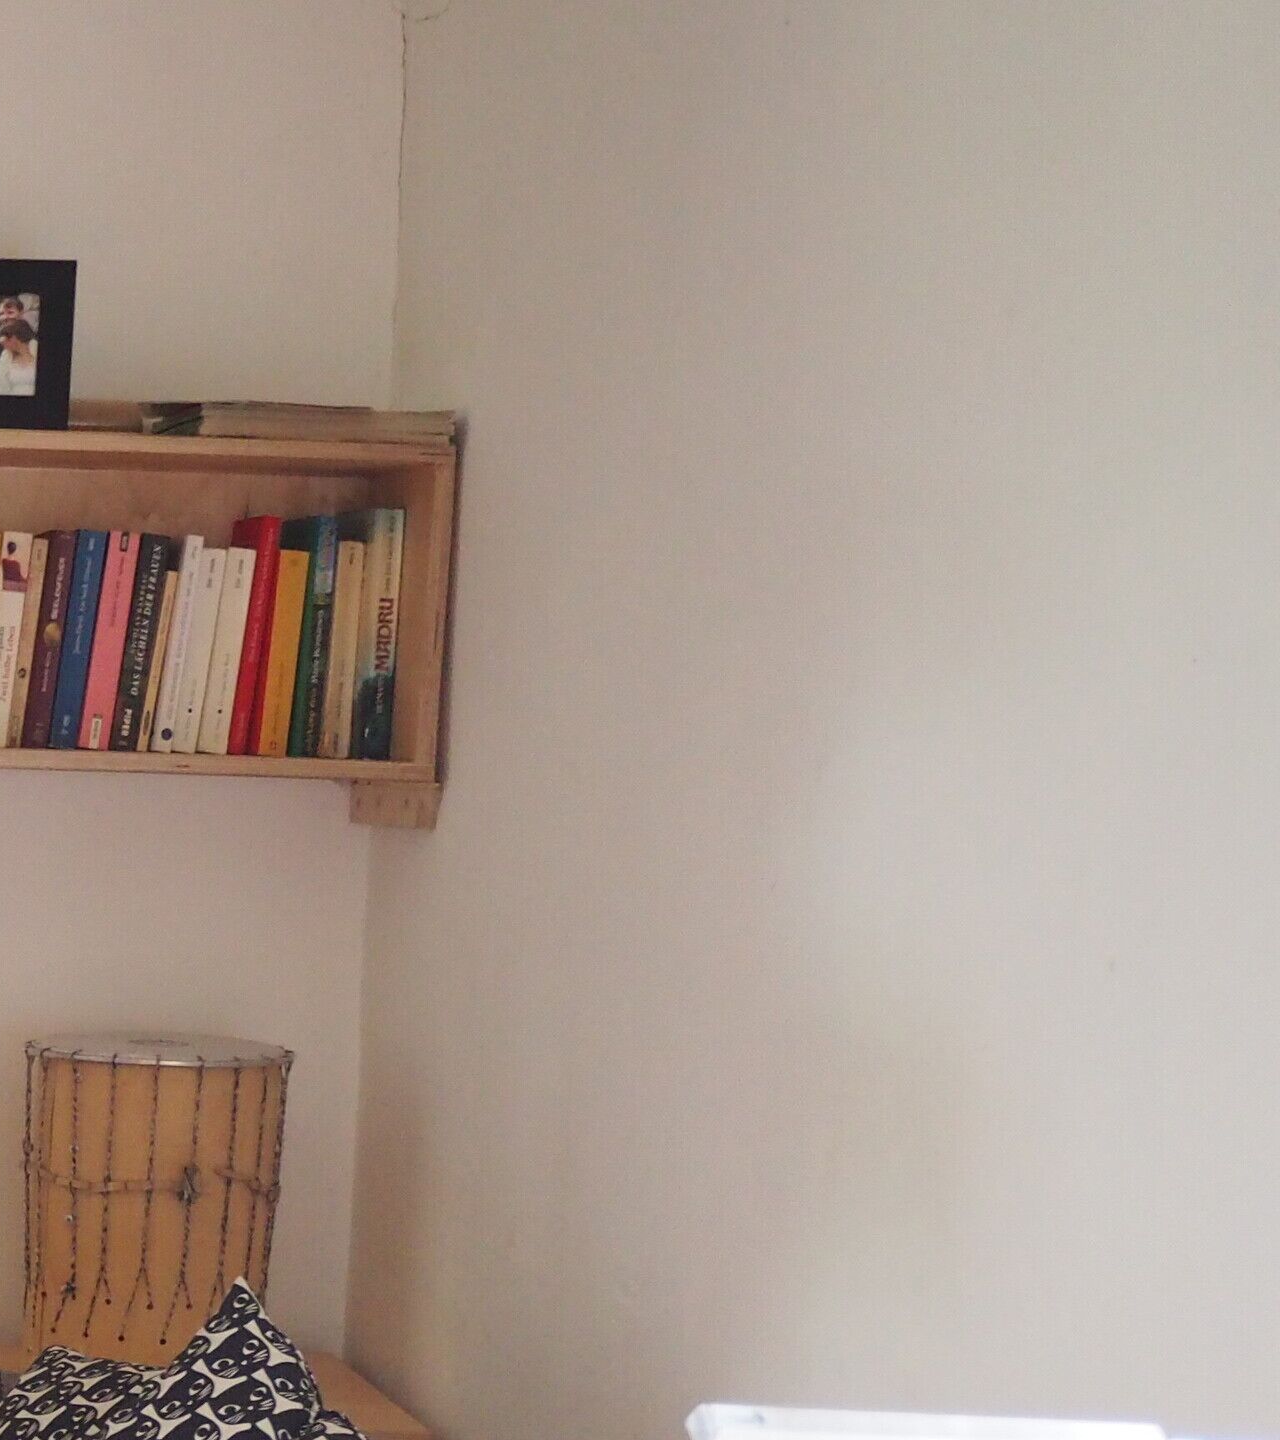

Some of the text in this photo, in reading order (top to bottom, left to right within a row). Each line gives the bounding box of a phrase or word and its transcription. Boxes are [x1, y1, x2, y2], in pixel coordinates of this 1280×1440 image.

[130, 544, 162, 696] DAS LÄCHELN DER FRAUEN
[4, 626, 16, 652] Leben
[374, 598, 394, 672] MADRU
[1, 654, 12, 679] halbe
[121, 708, 133, 737] PIPER
